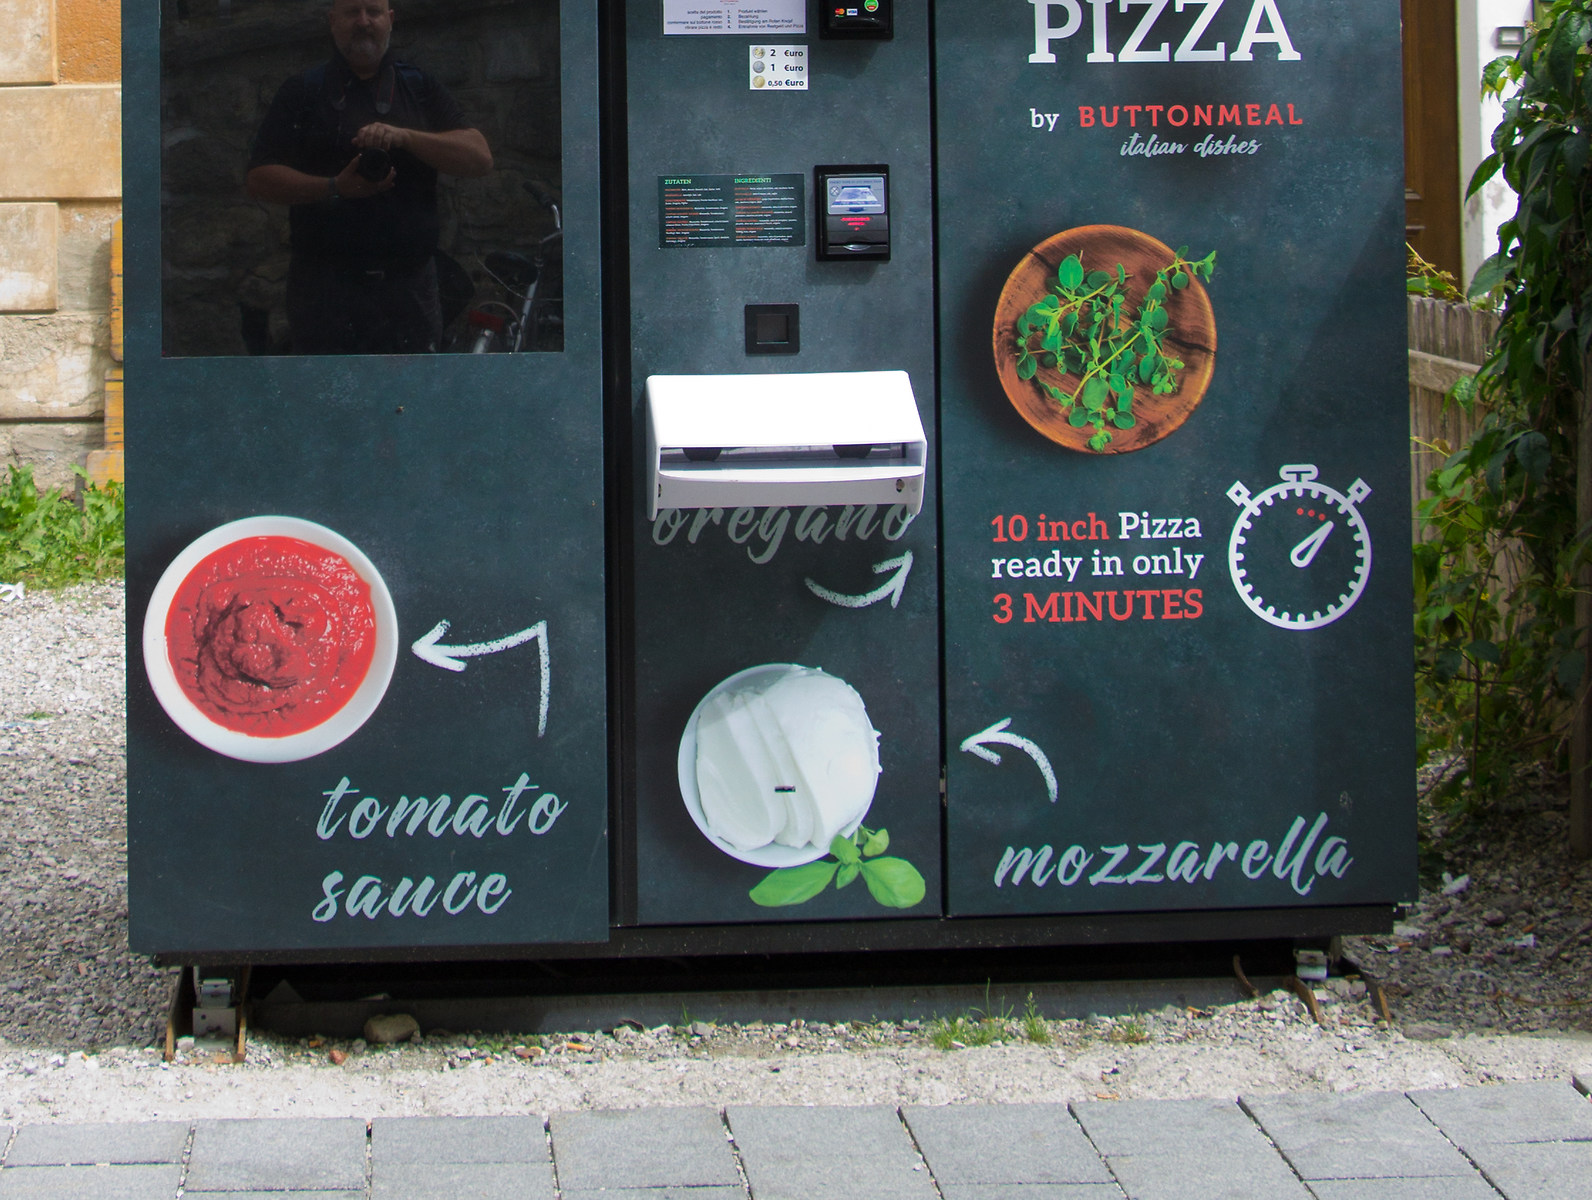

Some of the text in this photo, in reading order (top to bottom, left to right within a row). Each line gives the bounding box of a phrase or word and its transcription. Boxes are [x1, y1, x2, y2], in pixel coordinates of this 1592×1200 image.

[770, 49, 776, 57] 2
[770, 64, 776, 72] 1
[767, 80, 783, 88] 0,50
[1030, 104, 1303, 131] by BUTTONMEAL
[1119, 132, 1263, 158] italian dishes
[652, 504, 919, 564] oregano
[991, 512, 1202, 542] 10 inch Pizza
[991, 548, 1204, 582] ready in only
[992, 589, 1204, 624] 3 MINUTES
[316, 772, 568, 840] tomato
[993, 811, 1354, 896] mozzarella
[312, 870, 512, 922] sauce
